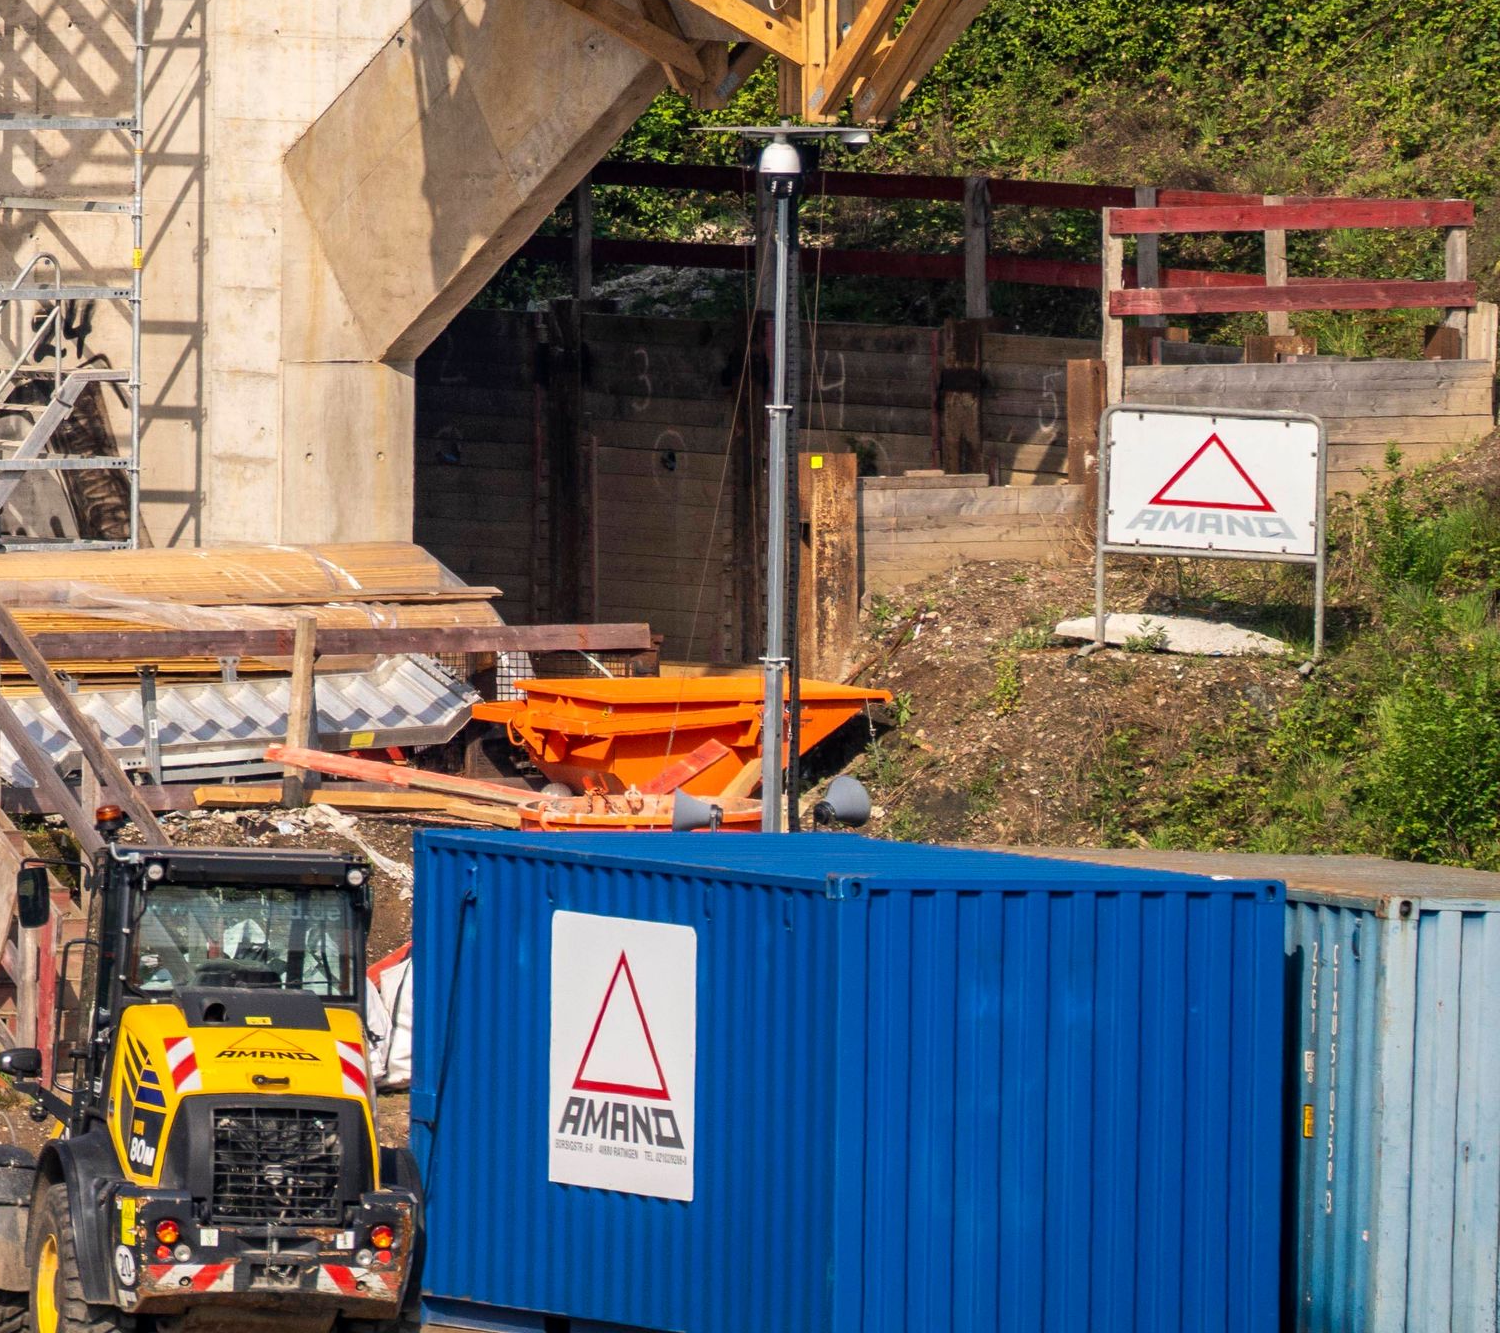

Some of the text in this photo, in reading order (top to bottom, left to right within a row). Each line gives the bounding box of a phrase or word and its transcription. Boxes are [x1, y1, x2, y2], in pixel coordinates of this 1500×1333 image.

[1124, 508, 1299, 541] AMAND
[215, 1050, 322, 1062] AMAND
[558, 1096, 685, 1150] AMAND
